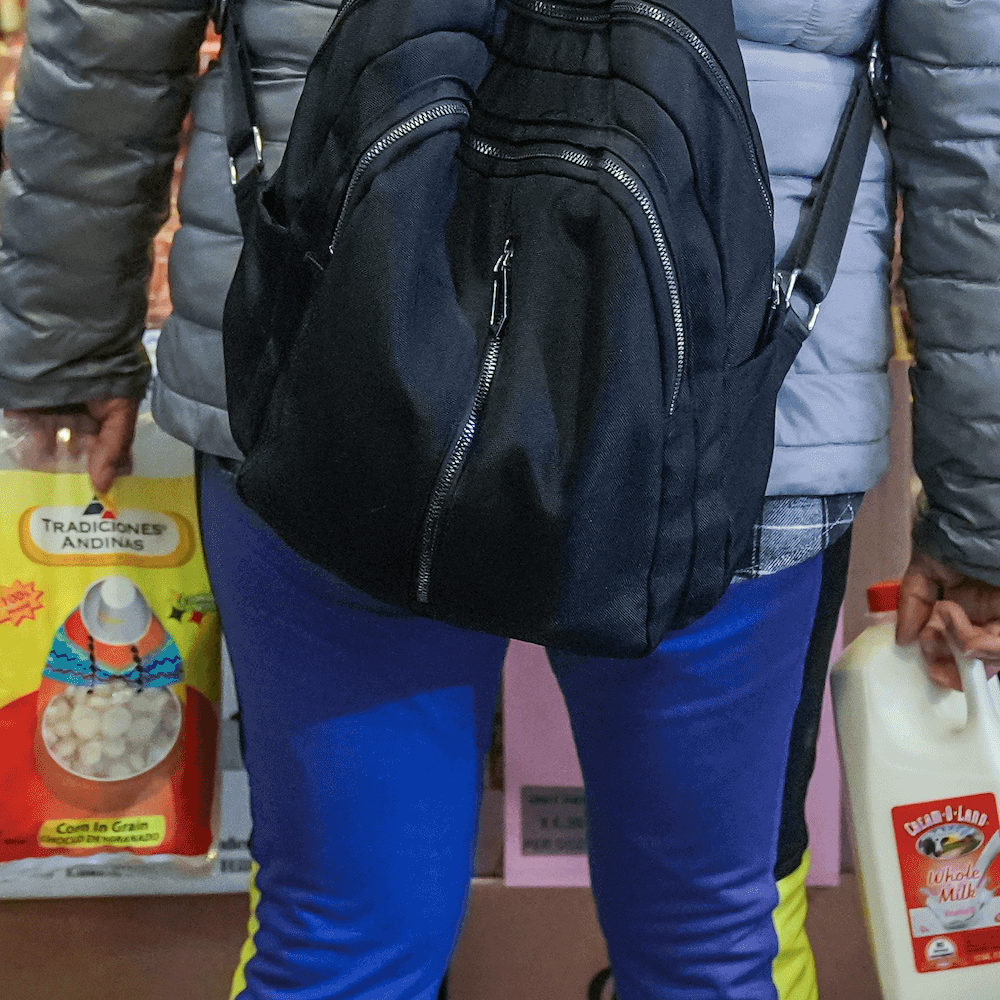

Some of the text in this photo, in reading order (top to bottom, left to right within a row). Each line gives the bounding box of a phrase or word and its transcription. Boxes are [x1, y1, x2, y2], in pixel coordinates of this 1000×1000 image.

[41, 518, 164, 536] TRADICIONES
[61, 536, 144, 552] ANDINAS
[55, 820, 149, 835] Corn In Grain
[927, 863, 982, 886] Whole
[938, 886, 978, 904] Milk
